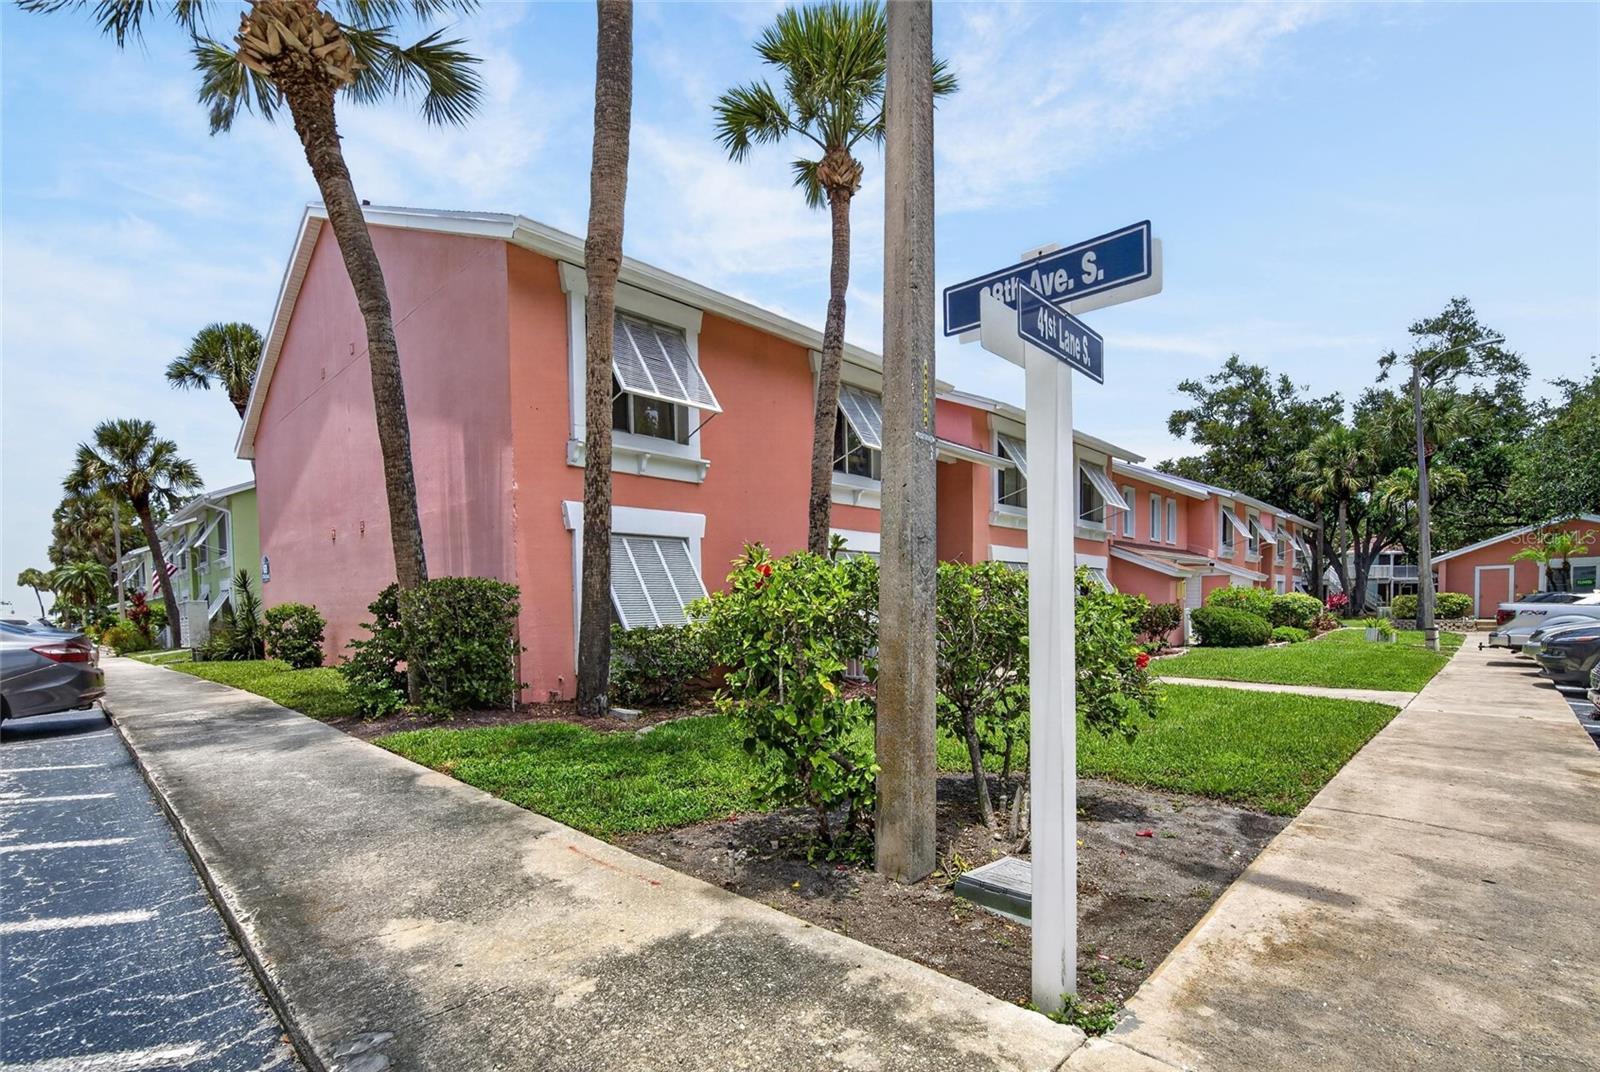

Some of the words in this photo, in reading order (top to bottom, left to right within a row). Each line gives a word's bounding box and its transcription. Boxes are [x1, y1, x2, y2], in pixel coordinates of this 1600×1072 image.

[1030, 268, 1075, 297] Ave.
[1081, 251, 1104, 284] S.
[1037, 306, 1057, 340] 41st
[1059, 318, 1081, 360] Lane
[1082, 335, 1091, 367] S.
